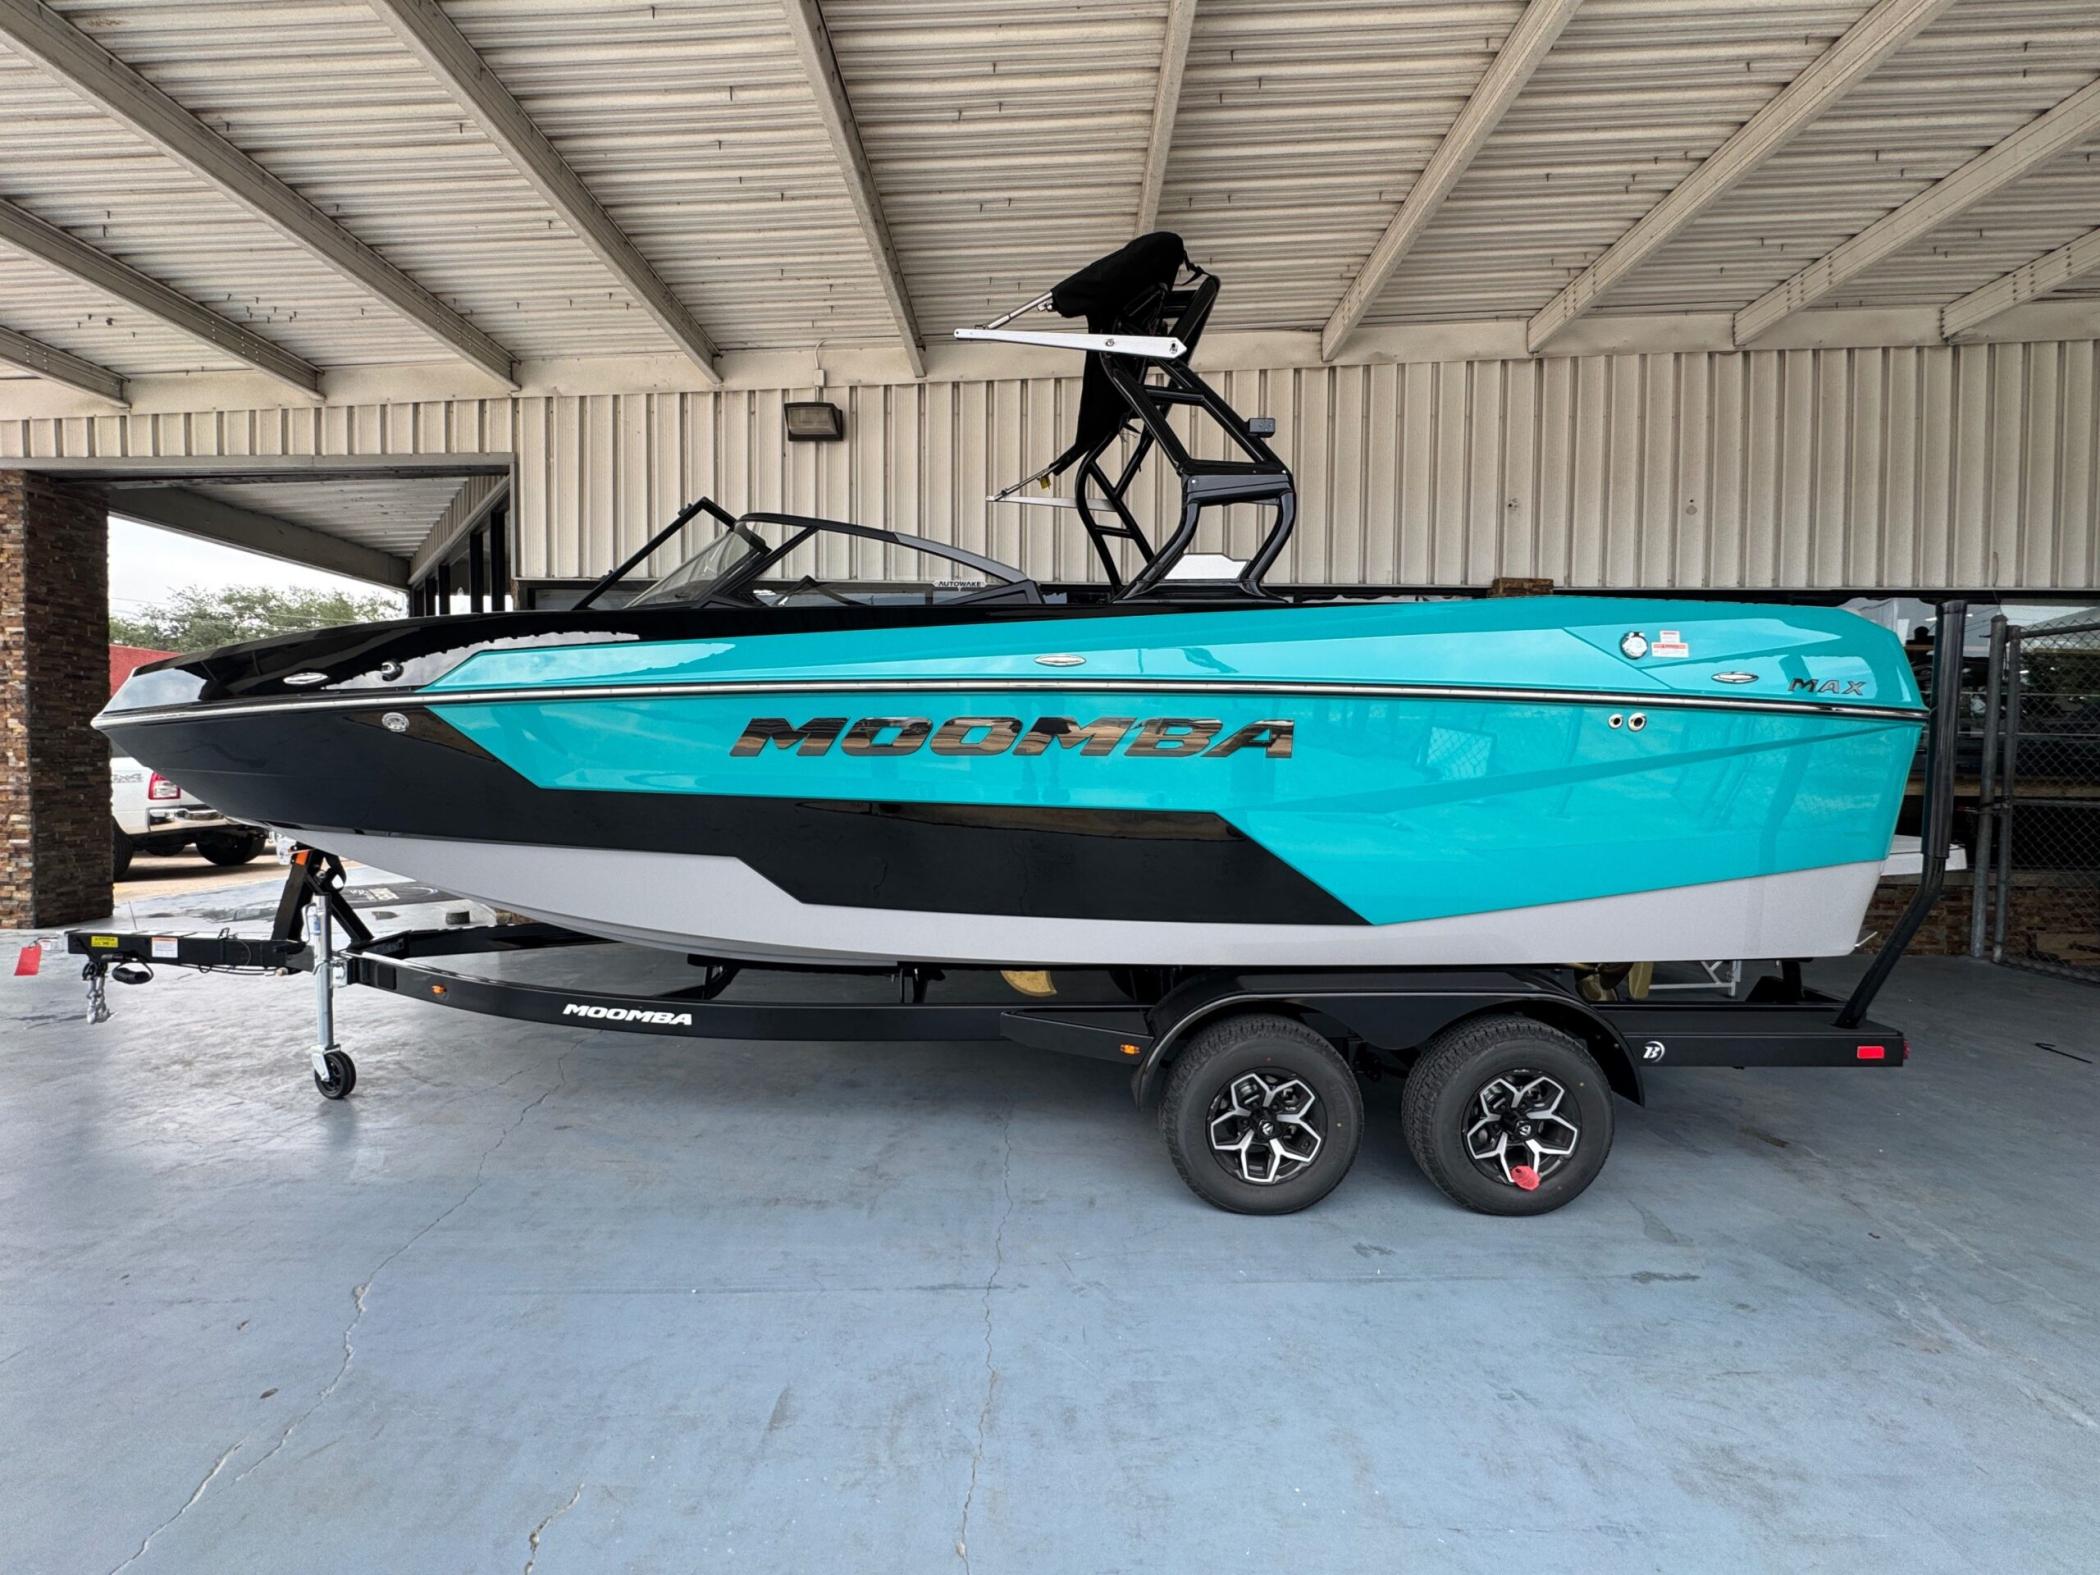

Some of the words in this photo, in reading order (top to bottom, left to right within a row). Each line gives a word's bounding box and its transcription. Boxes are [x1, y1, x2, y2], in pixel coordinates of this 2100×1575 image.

[1788, 678, 1867, 696] MAX
[729, 717, 1295, 758] MOOMBA
[562, 1003, 693, 1026] MOOMBA
